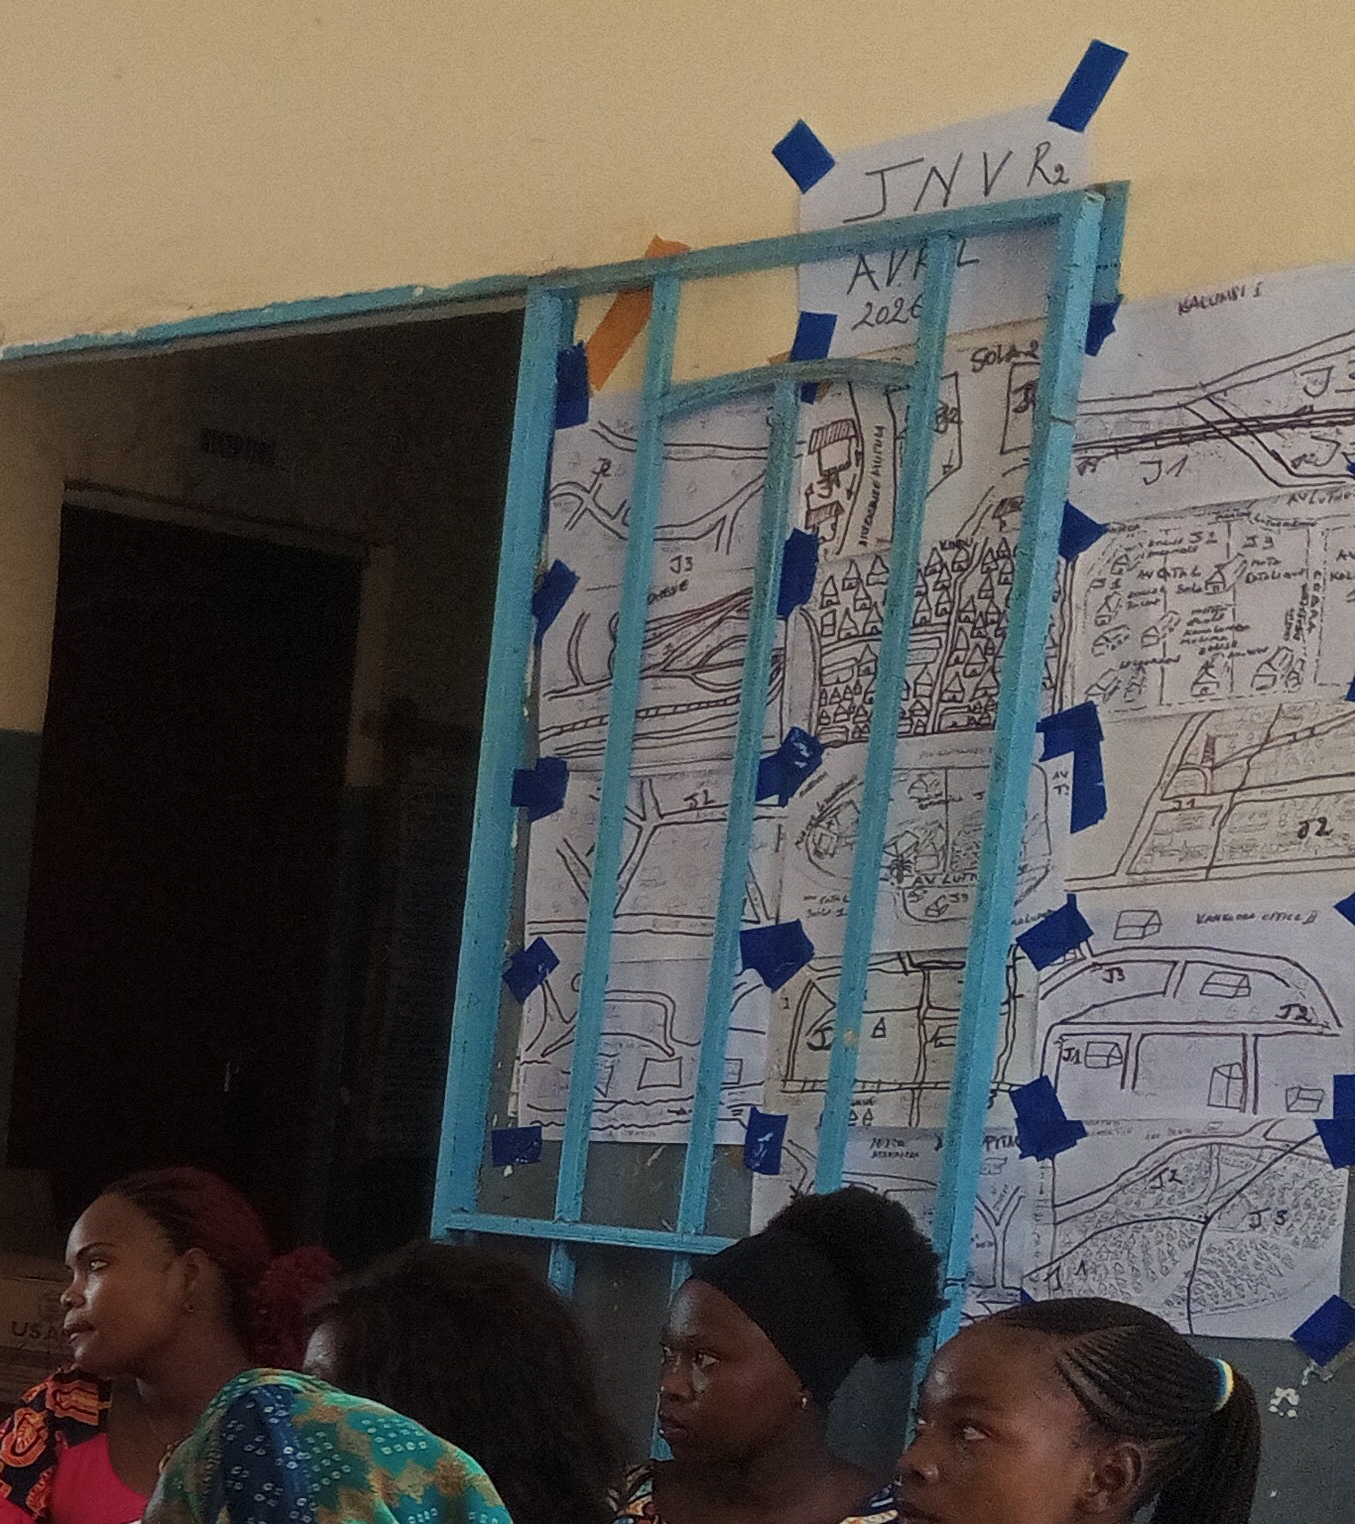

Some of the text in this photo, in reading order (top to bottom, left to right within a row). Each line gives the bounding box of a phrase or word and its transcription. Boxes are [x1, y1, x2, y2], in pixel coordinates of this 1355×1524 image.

[846, 237, 980, 297] AVRL
[669, 554, 693, 575] J3
[1296, 815, 1335, 840] J2
